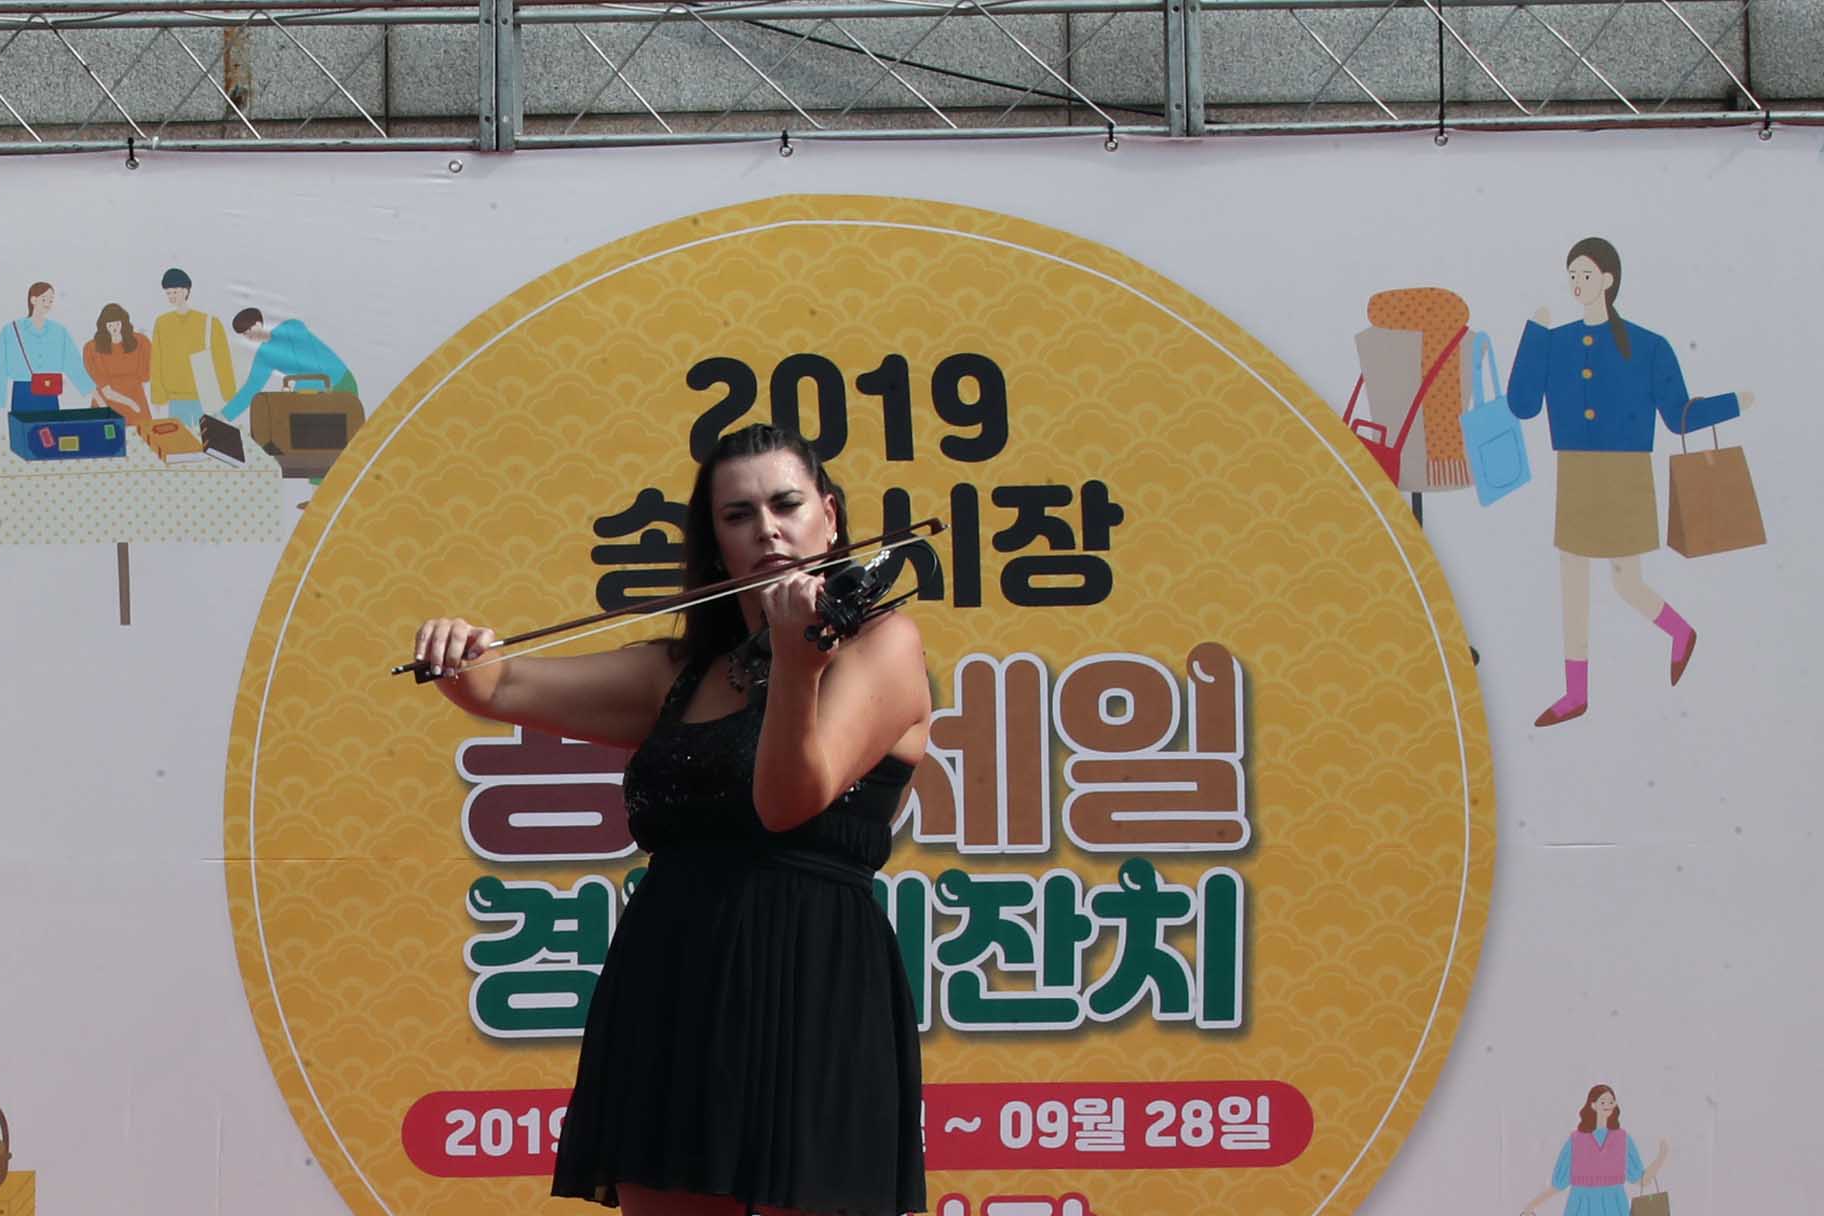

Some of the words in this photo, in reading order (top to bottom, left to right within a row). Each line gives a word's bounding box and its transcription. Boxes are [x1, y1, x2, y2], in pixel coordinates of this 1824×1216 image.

[685, 352, 1009, 464] 2019
[590, 479, 1126, 614] 송시장
[455, 641, 1252, 861] 세일
[463, 856, 1246, 1039] 경잔치
[444, 1107, 570, 1157] 201
[999, 1097, 1127, 1153] 09월
[1144, 1095, 1272, 1151] 28일
